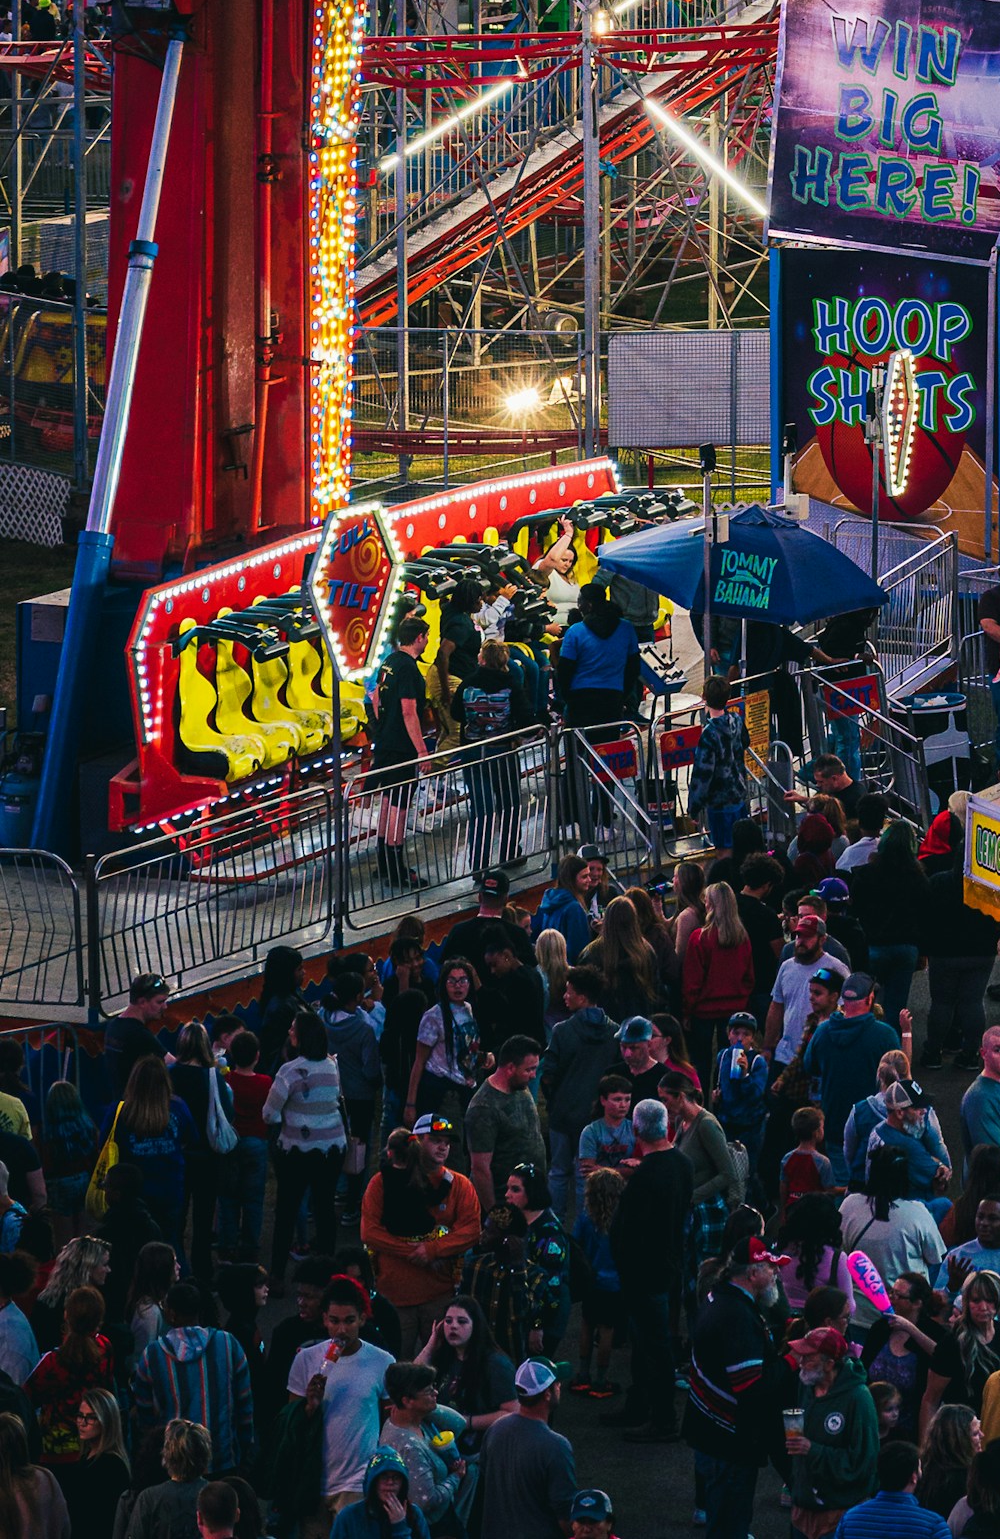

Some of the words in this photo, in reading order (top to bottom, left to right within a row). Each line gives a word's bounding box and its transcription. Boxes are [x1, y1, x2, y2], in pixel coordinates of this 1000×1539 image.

[831, 16, 962, 87] WIN
[834, 83, 944, 155] BIG
[789, 144, 981, 228] HERE!
[811, 295, 974, 362] HOOP
[807, 366, 977, 434] SHTS
[329, 518, 373, 563] FULL
[720, 549, 778, 586] TOMMY
[327, 579, 378, 611] TILT
[713, 580, 771, 610] BAHAMA
[829, 683, 873, 711] EXIT
